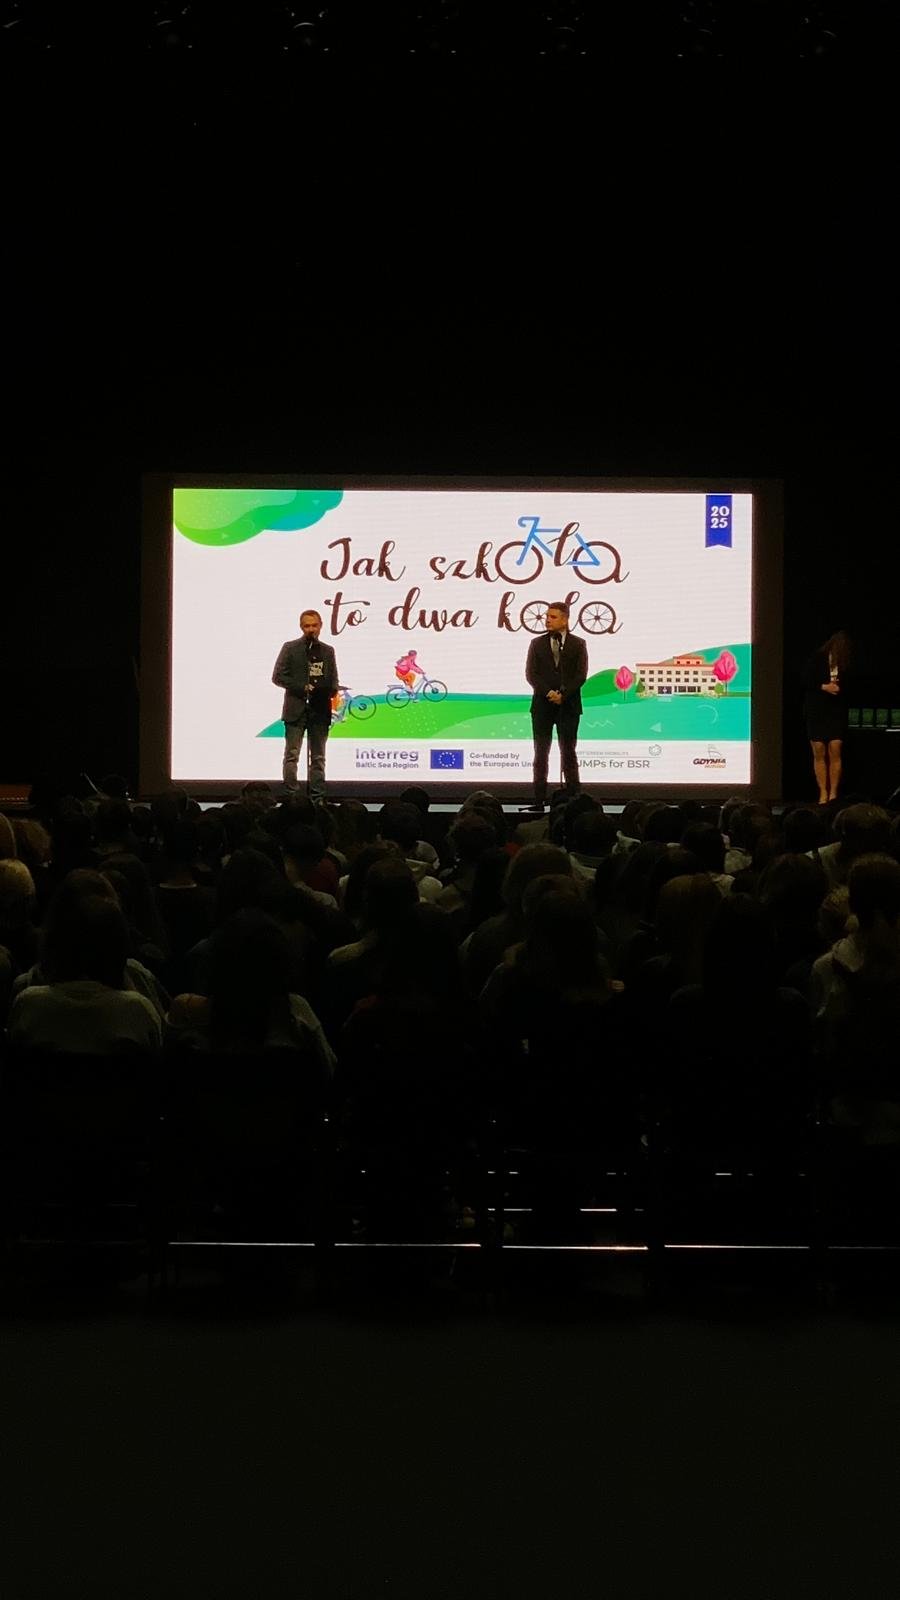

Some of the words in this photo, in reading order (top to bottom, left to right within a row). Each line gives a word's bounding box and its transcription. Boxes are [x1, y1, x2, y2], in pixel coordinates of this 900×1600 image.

[711, 505, 730, 516] 20
[711, 517, 729, 529] 25
[320, 537, 406, 581] Jak
[324, 591, 371, 636] to
[388, 586, 479, 632] dwa
[356, 748, 419, 762] Interreg
[510, 752, 520, 760] by
[392, 762, 419, 770] Region
[483, 760, 520, 768] European
[577, 759, 607, 769] UMPs
[609, 759, 624, 768] for
[627, 759, 650, 769] BSR
